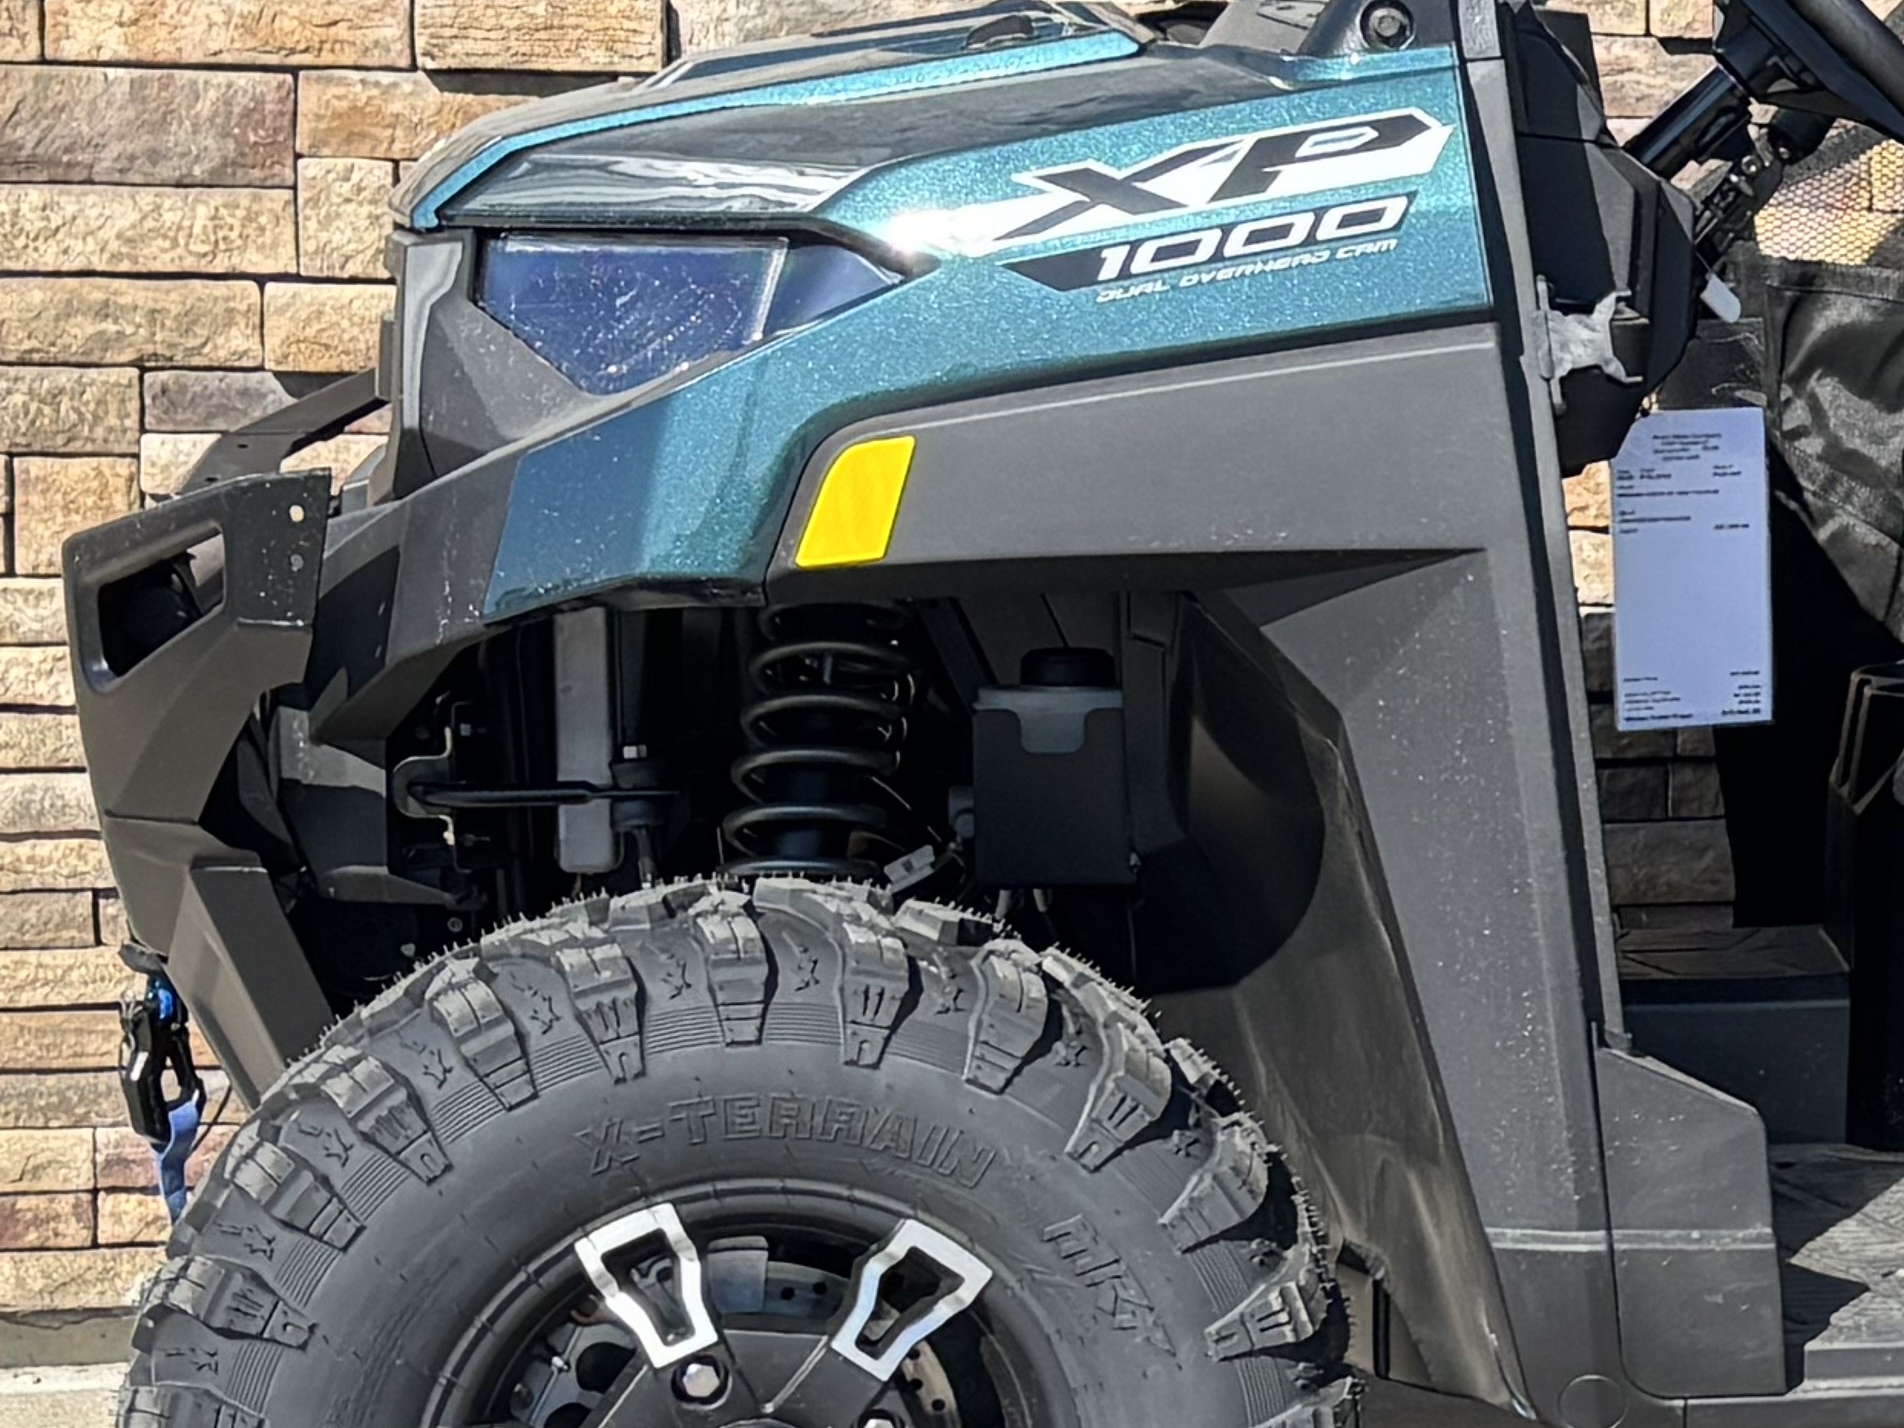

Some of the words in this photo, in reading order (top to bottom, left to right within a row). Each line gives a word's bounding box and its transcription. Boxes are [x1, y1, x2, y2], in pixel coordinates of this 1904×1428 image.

[992, 112, 1433, 242] XP
[1096, 278, 1171, 303] DUAL
[1178, 249, 1330, 289] OVERHEAD
[1335, 237, 1400, 261] CAM
[1097, 194, 1410, 283] 1000
[574, 1090, 997, 1190] X-TERRAIN
